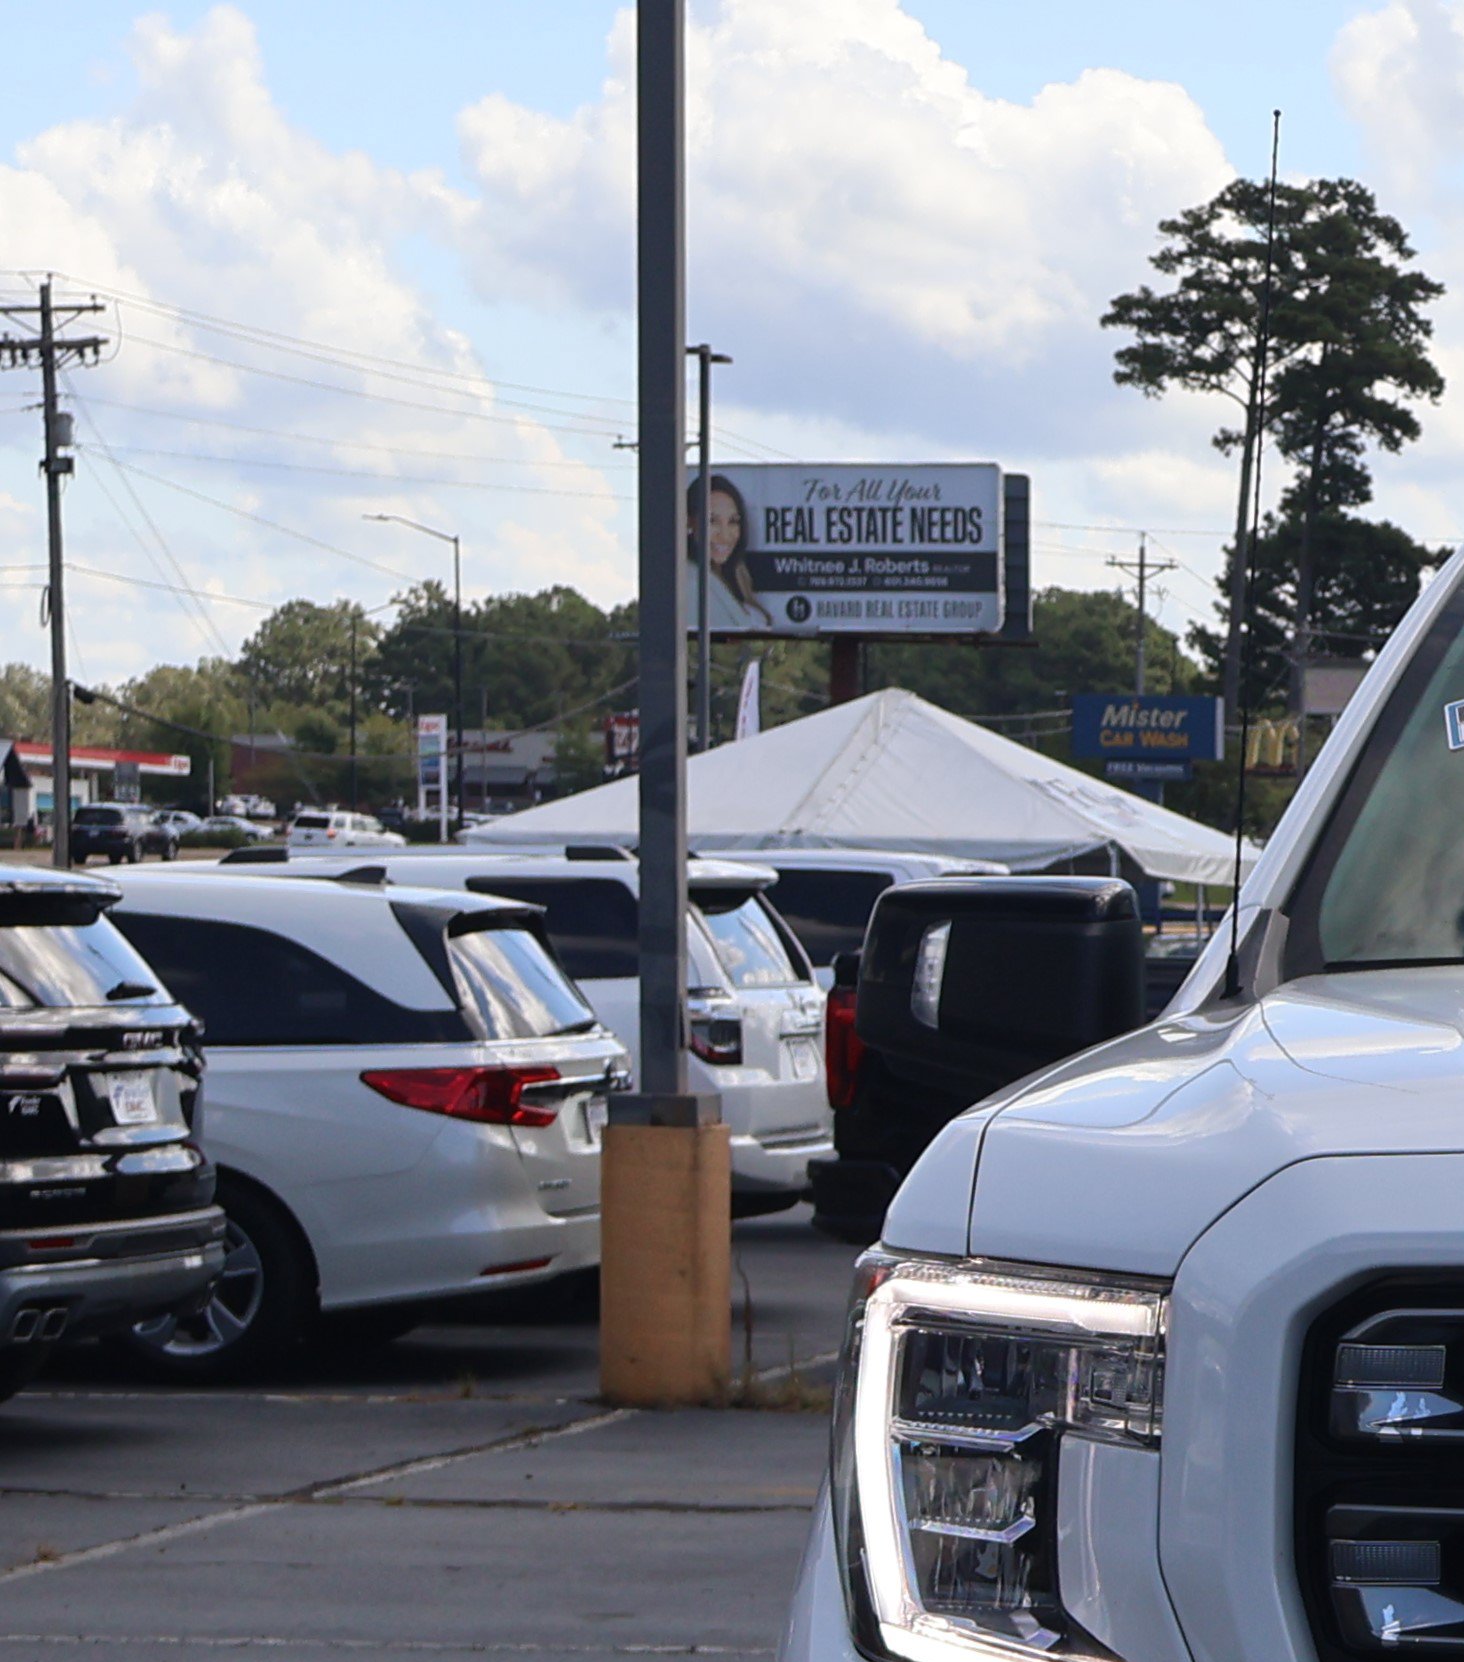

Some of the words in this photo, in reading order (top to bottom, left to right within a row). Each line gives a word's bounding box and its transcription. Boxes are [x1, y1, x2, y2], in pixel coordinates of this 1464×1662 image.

[804, 478, 842, 501] For
[848, 478, 882, 501] All
[886, 478, 942, 507] Your
[765, 507, 819, 544] REAL
[826, 507, 904, 544] ESTATE
[911, 506, 983, 544] NEEDS
[775, 557, 844, 574] Whitnee
[848, 557, 862, 574] J.
[865, 557, 930, 574] Roberts
[866, 601, 893, 618] REAL
[898, 601, 938, 618] ESTATE
[943, 601, 983, 618] GROUP
[1102, 702, 1187, 728] Mister
